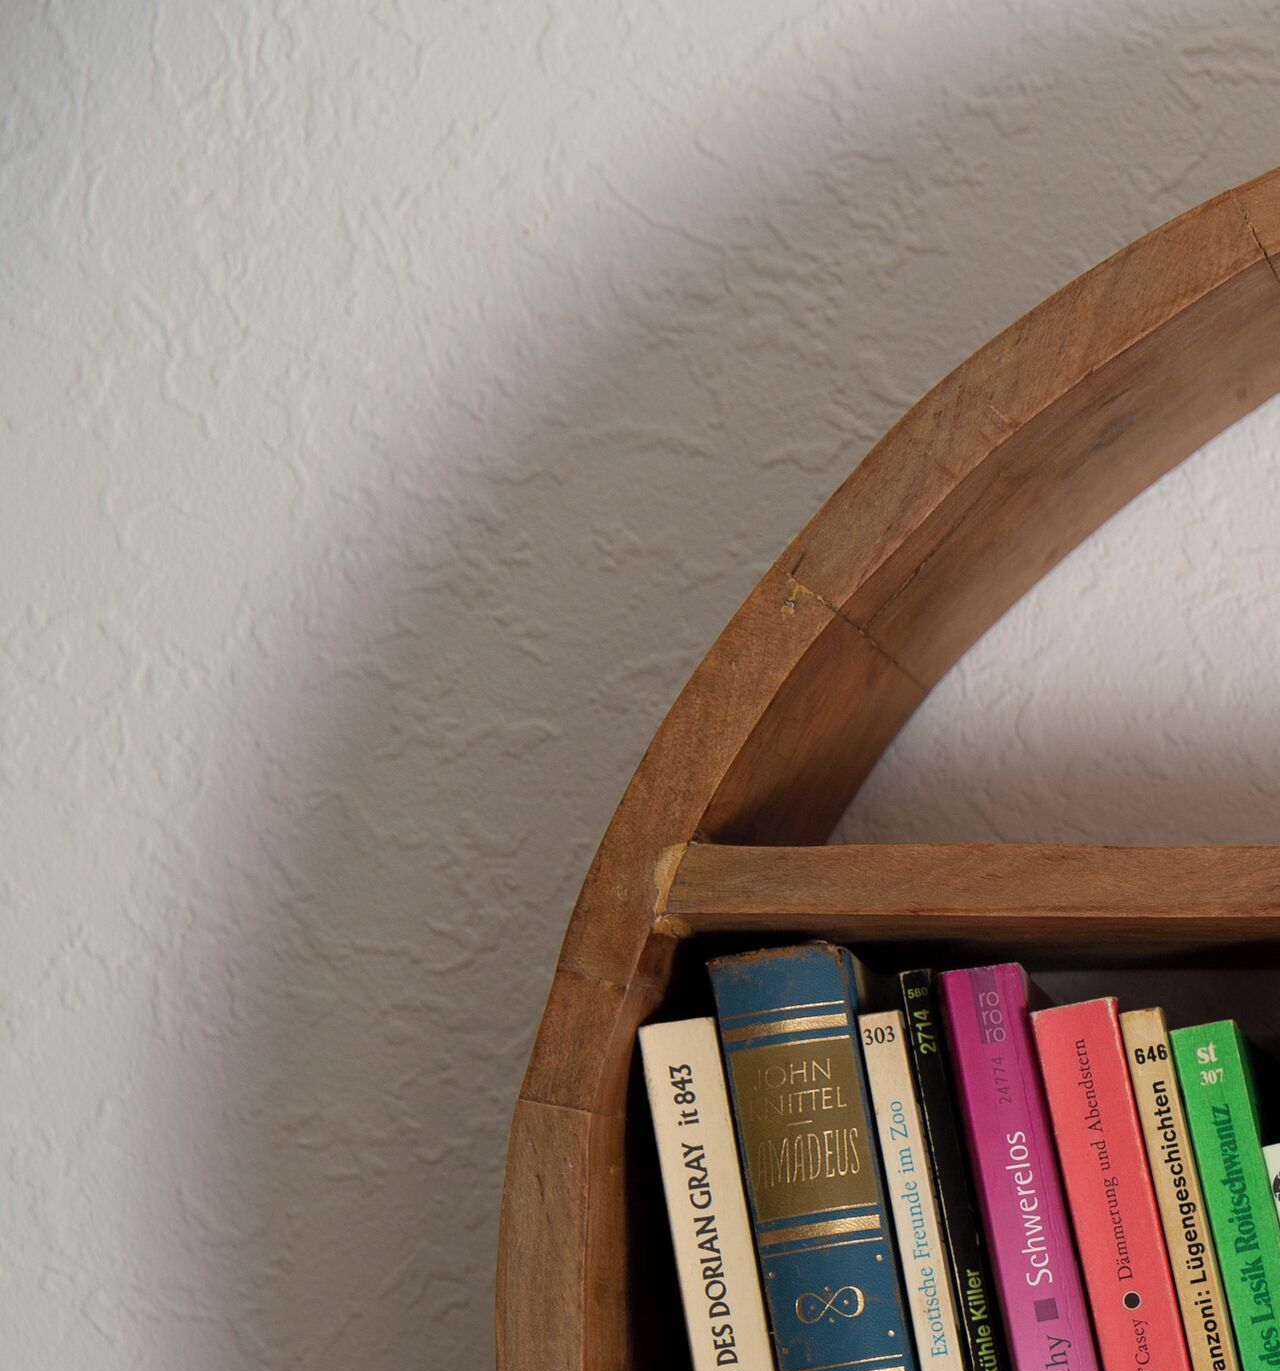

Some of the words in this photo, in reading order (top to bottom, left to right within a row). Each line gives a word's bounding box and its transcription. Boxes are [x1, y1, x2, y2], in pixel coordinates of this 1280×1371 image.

[978, 991, 999, 1008] ro
[982, 1009, 1003, 1026] ro
[863, 1025, 895, 1046] 303
[913, 1009, 937, 1055] 2714
[985, 1027, 1006, 1044] ro
[1196, 1041, 1218, 1065] st
[753, 1058, 832, 1091] JOHN
[1134, 1044, 1168, 1066] 646
[1200, 1068, 1224, 1086] 307
[669, 1063, 697, 1106] 843
[1075, 1039, 1103, 1133] Abendstern
[678, 1107, 700, 1127] it
[889, 1100, 909, 1141] Zoo
[681, 1142, 712, 1209] GRAY
[757, 1127, 860, 1191] AMADEUS
[897, 1146, 916, 1173] im
[1090, 1140, 1112, 1172] und
[1152, 1079, 1206, 1286] Lügengeschichten
[1211, 1103, 1260, 1255] Roitschwantz
[901, 1180, 932, 1260] Freunde
[1005, 1130, 1054, 1288] Schwerelos
[1105, 1176, 1133, 1282] Dämmerung
[693, 1213, 732, 1319] DORIAN
[917, 1266, 948, 1359] Exotische
[966, 1269, 990, 1322] Killer
[1240, 1256, 1275, 1325] Lasik
[712, 1322, 739, 1367] DES
